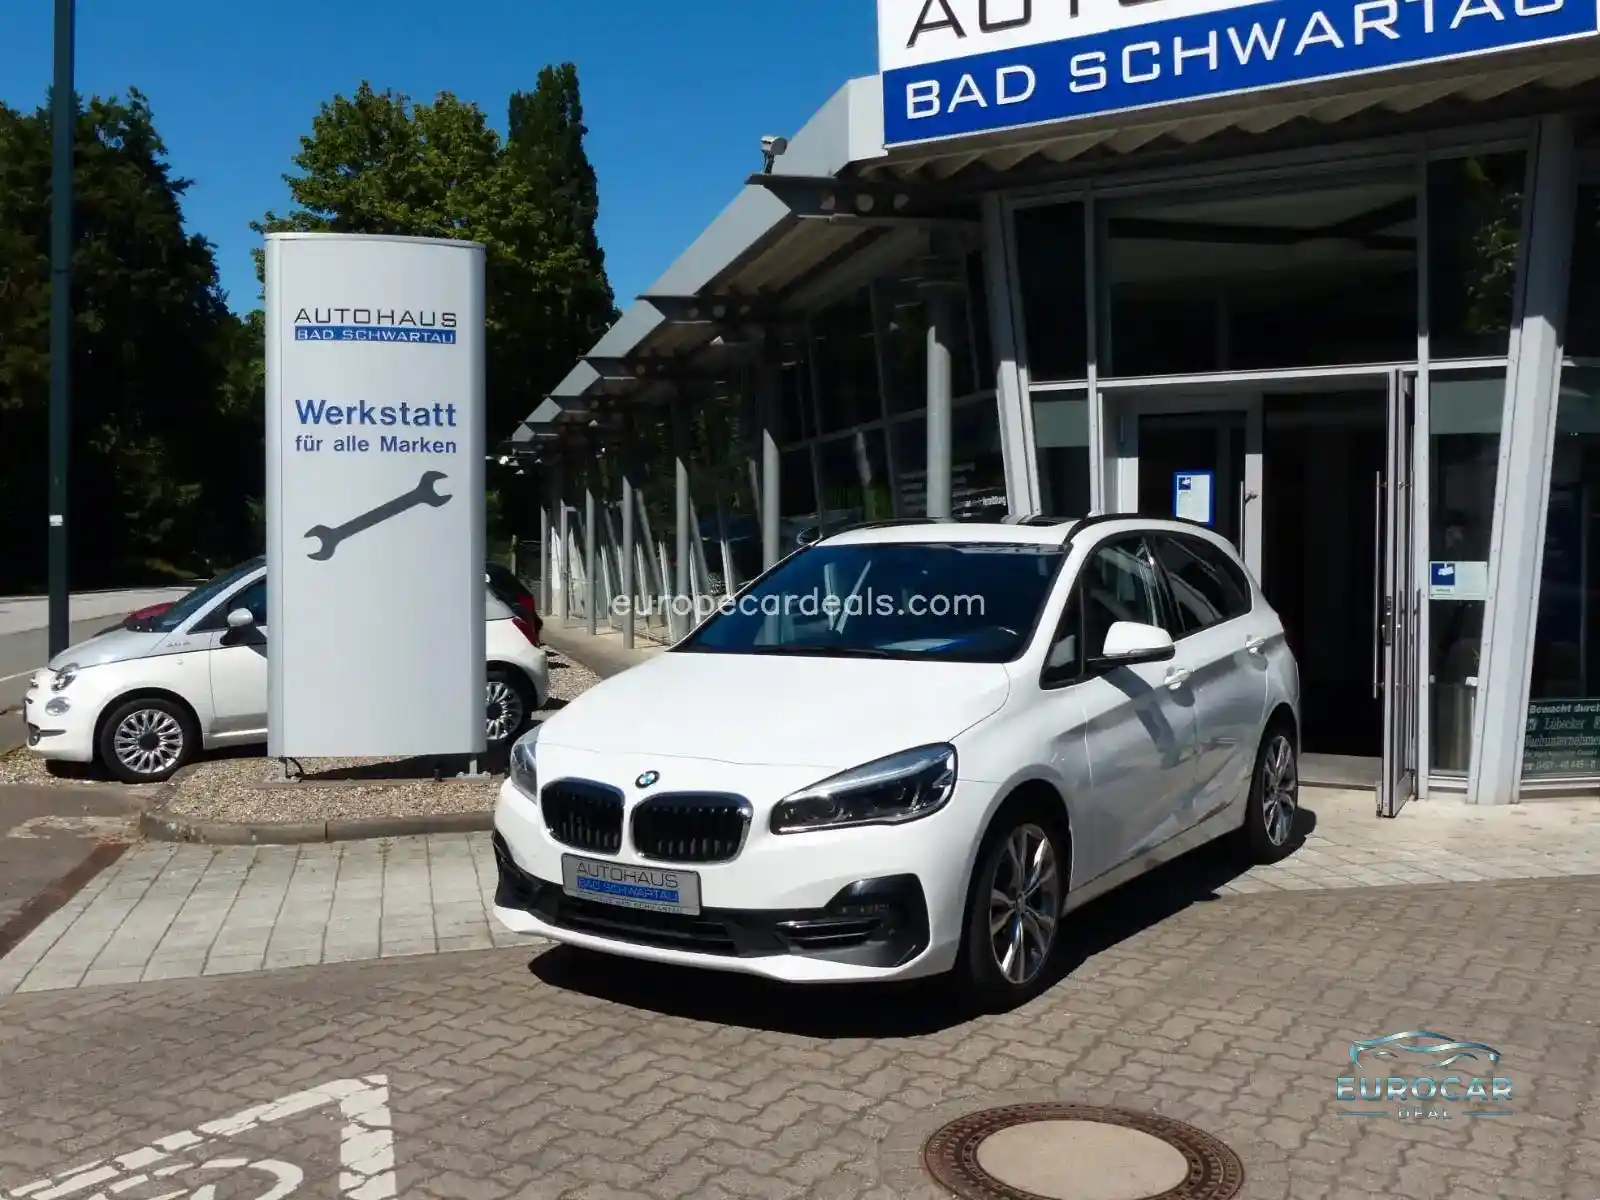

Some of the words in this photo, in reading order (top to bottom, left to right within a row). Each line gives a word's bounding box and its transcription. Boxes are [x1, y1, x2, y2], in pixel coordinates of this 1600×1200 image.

[906, 65, 1036, 120] BAD
[294, 308, 457, 328] AUTOHAUS
[297, 329, 334, 340] BAD
[342, 330, 454, 343] SCHWARTAU
[295, 400, 457, 427] Werkstatt
[295, 435, 323, 452] für
[333, 435, 370, 452] alle
[380, 436, 457, 454] Marken
[1529, 704, 1572, 714] Bewacht
[1543, 716, 1587, 731] Lübecker
[577, 862, 679, 888] AUTOHAUS
